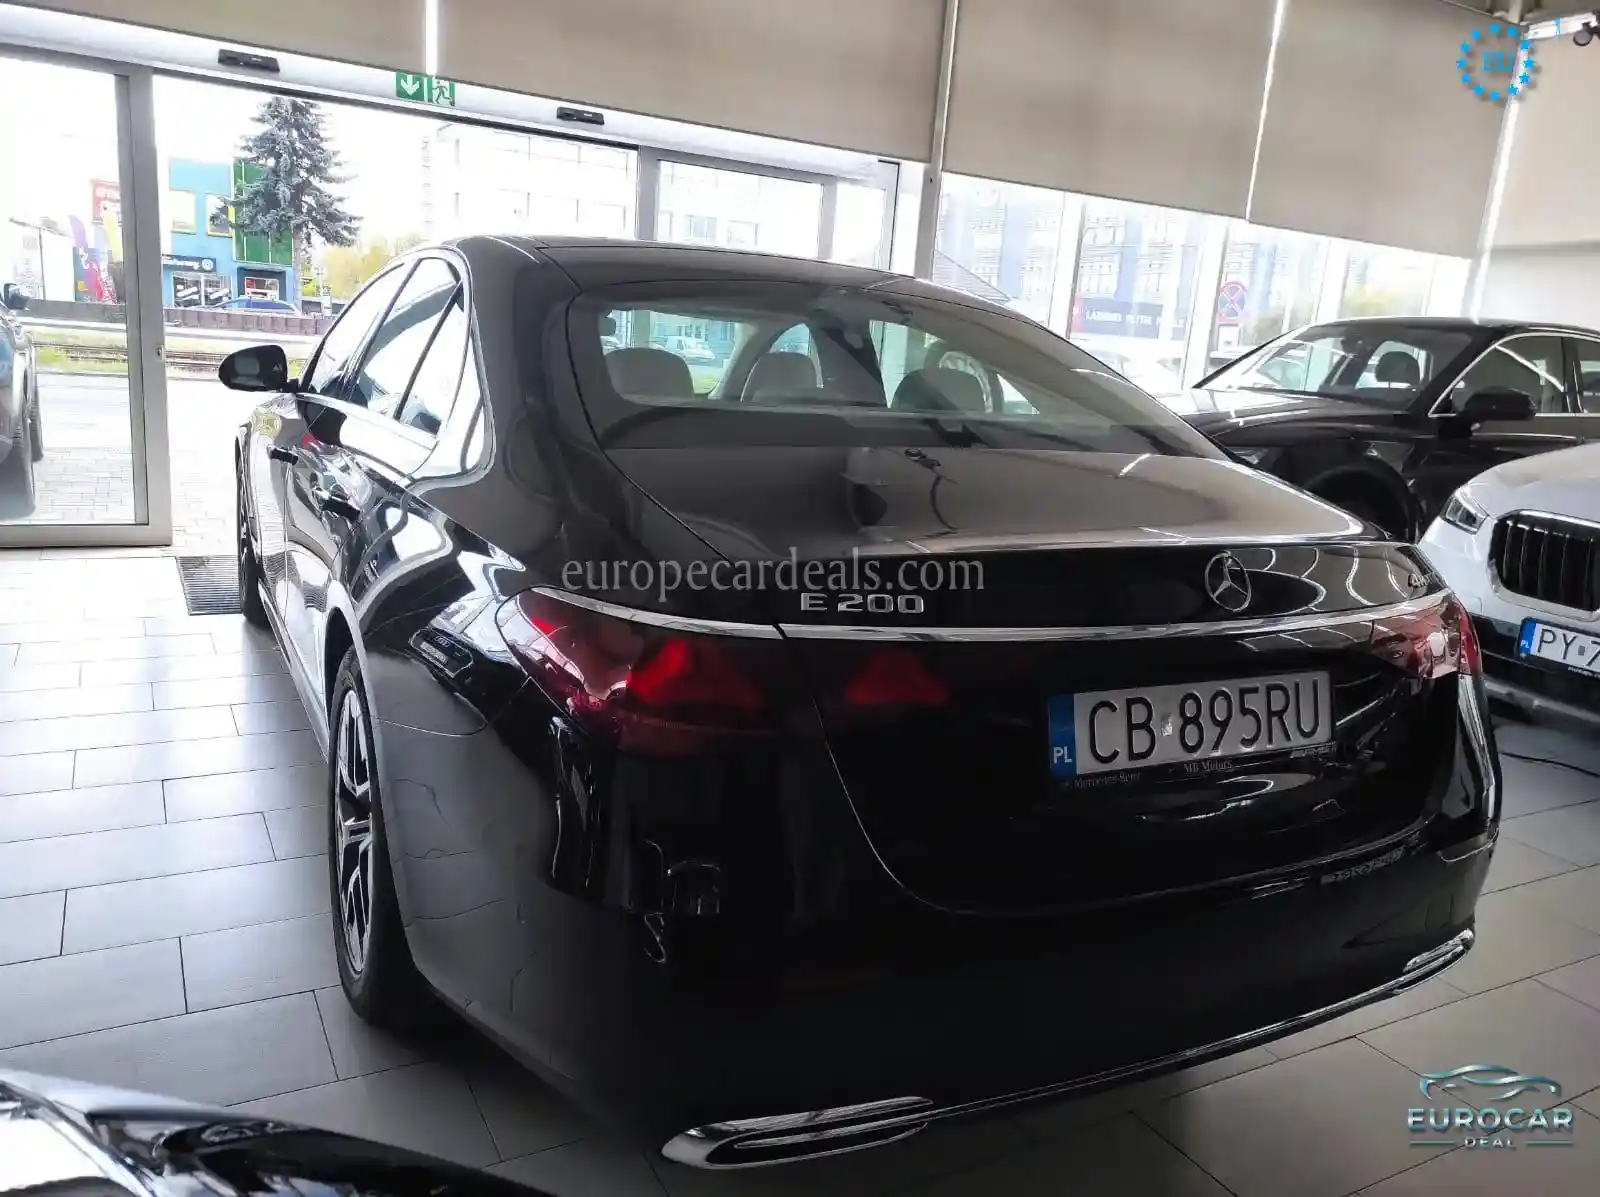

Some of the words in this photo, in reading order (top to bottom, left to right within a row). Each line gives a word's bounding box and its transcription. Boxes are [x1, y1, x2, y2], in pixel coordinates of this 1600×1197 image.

[800, 592, 829, 613] E
[837, 593, 925, 614] 200
[1520, 639, 1530, 649] PL
[1537, 628, 1578, 660] PY
[1088, 696, 1157, 764] CB
[1178, 678, 1320, 758] 895RU
[1053, 745, 1073, 764] PL
